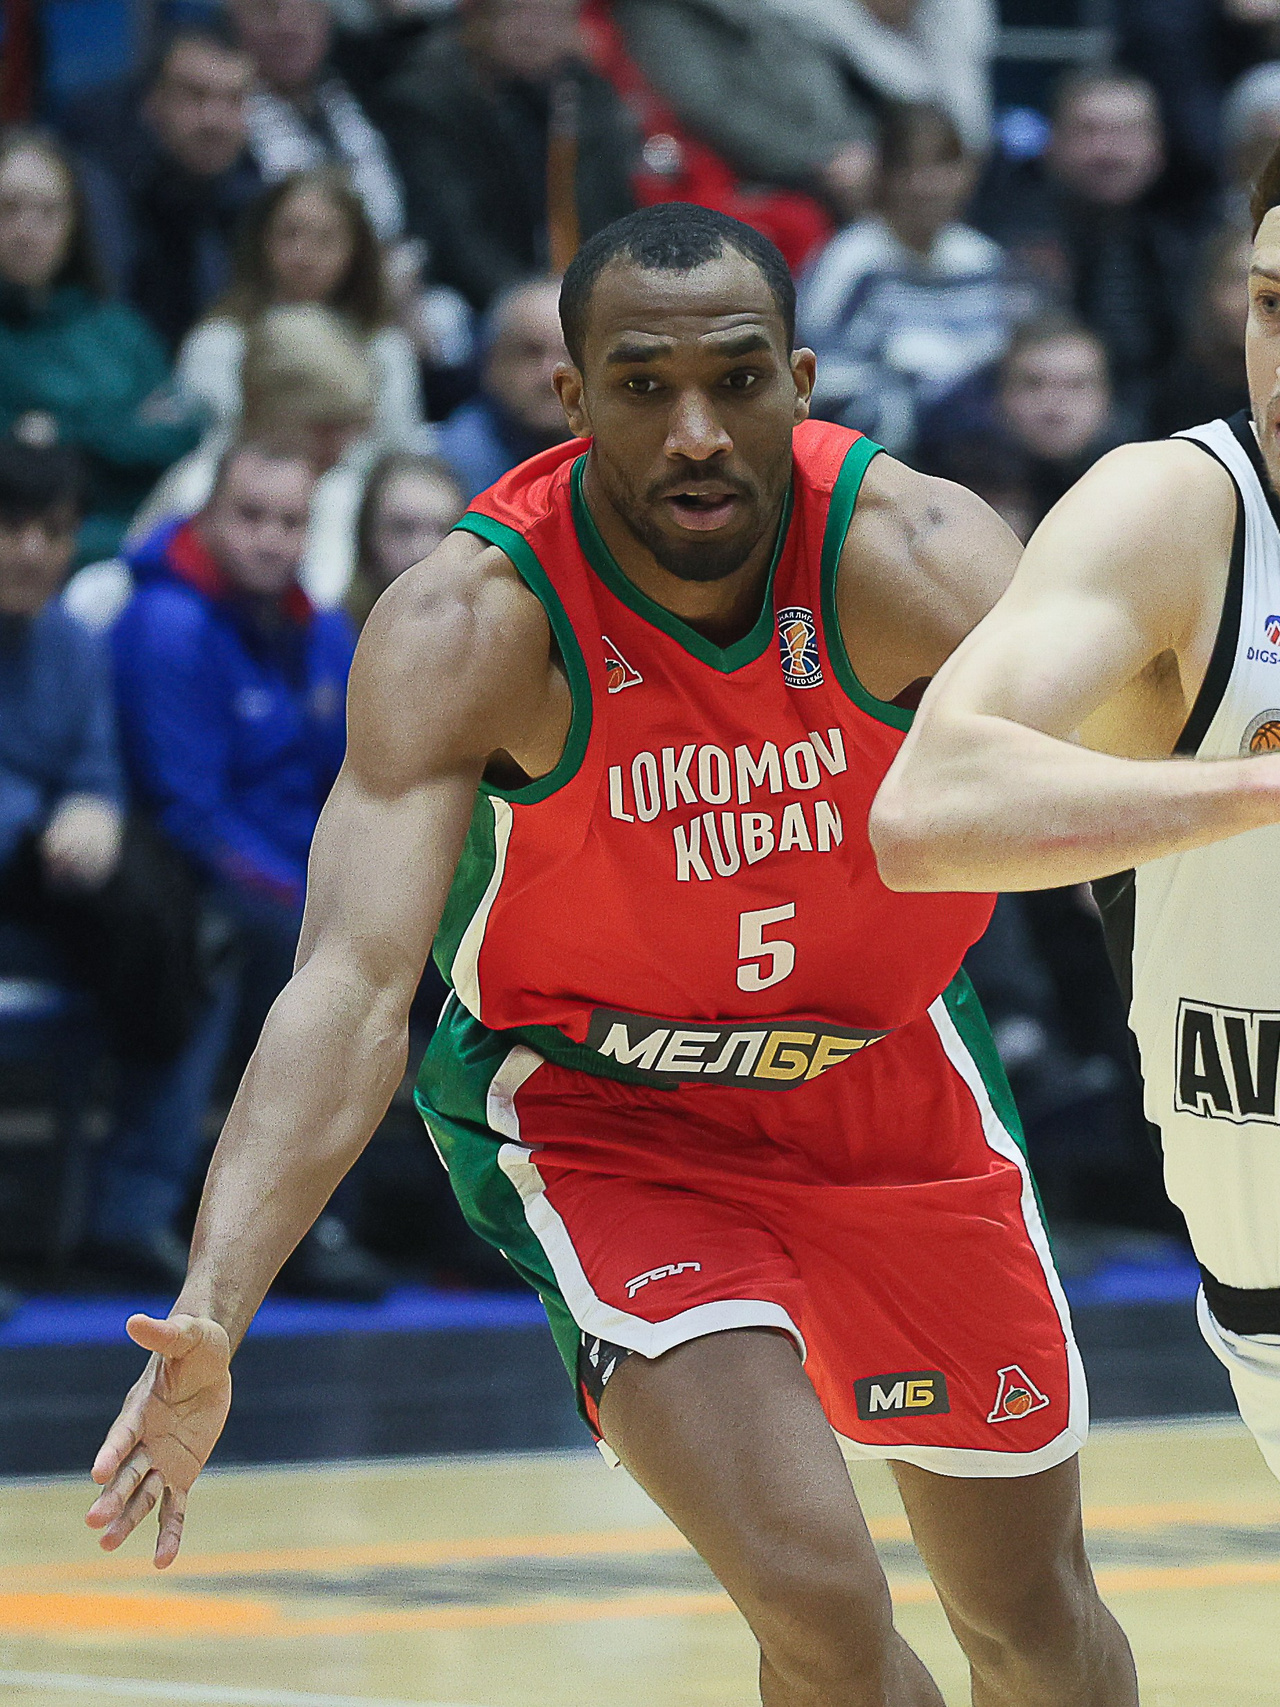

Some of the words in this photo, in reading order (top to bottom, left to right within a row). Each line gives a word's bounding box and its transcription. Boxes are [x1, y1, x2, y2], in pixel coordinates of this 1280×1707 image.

[672, 800, 844, 882] KUBAN
[736, 902, 797, 993] 5
[597, 1023, 887, 1082] МЕЛБЕ
